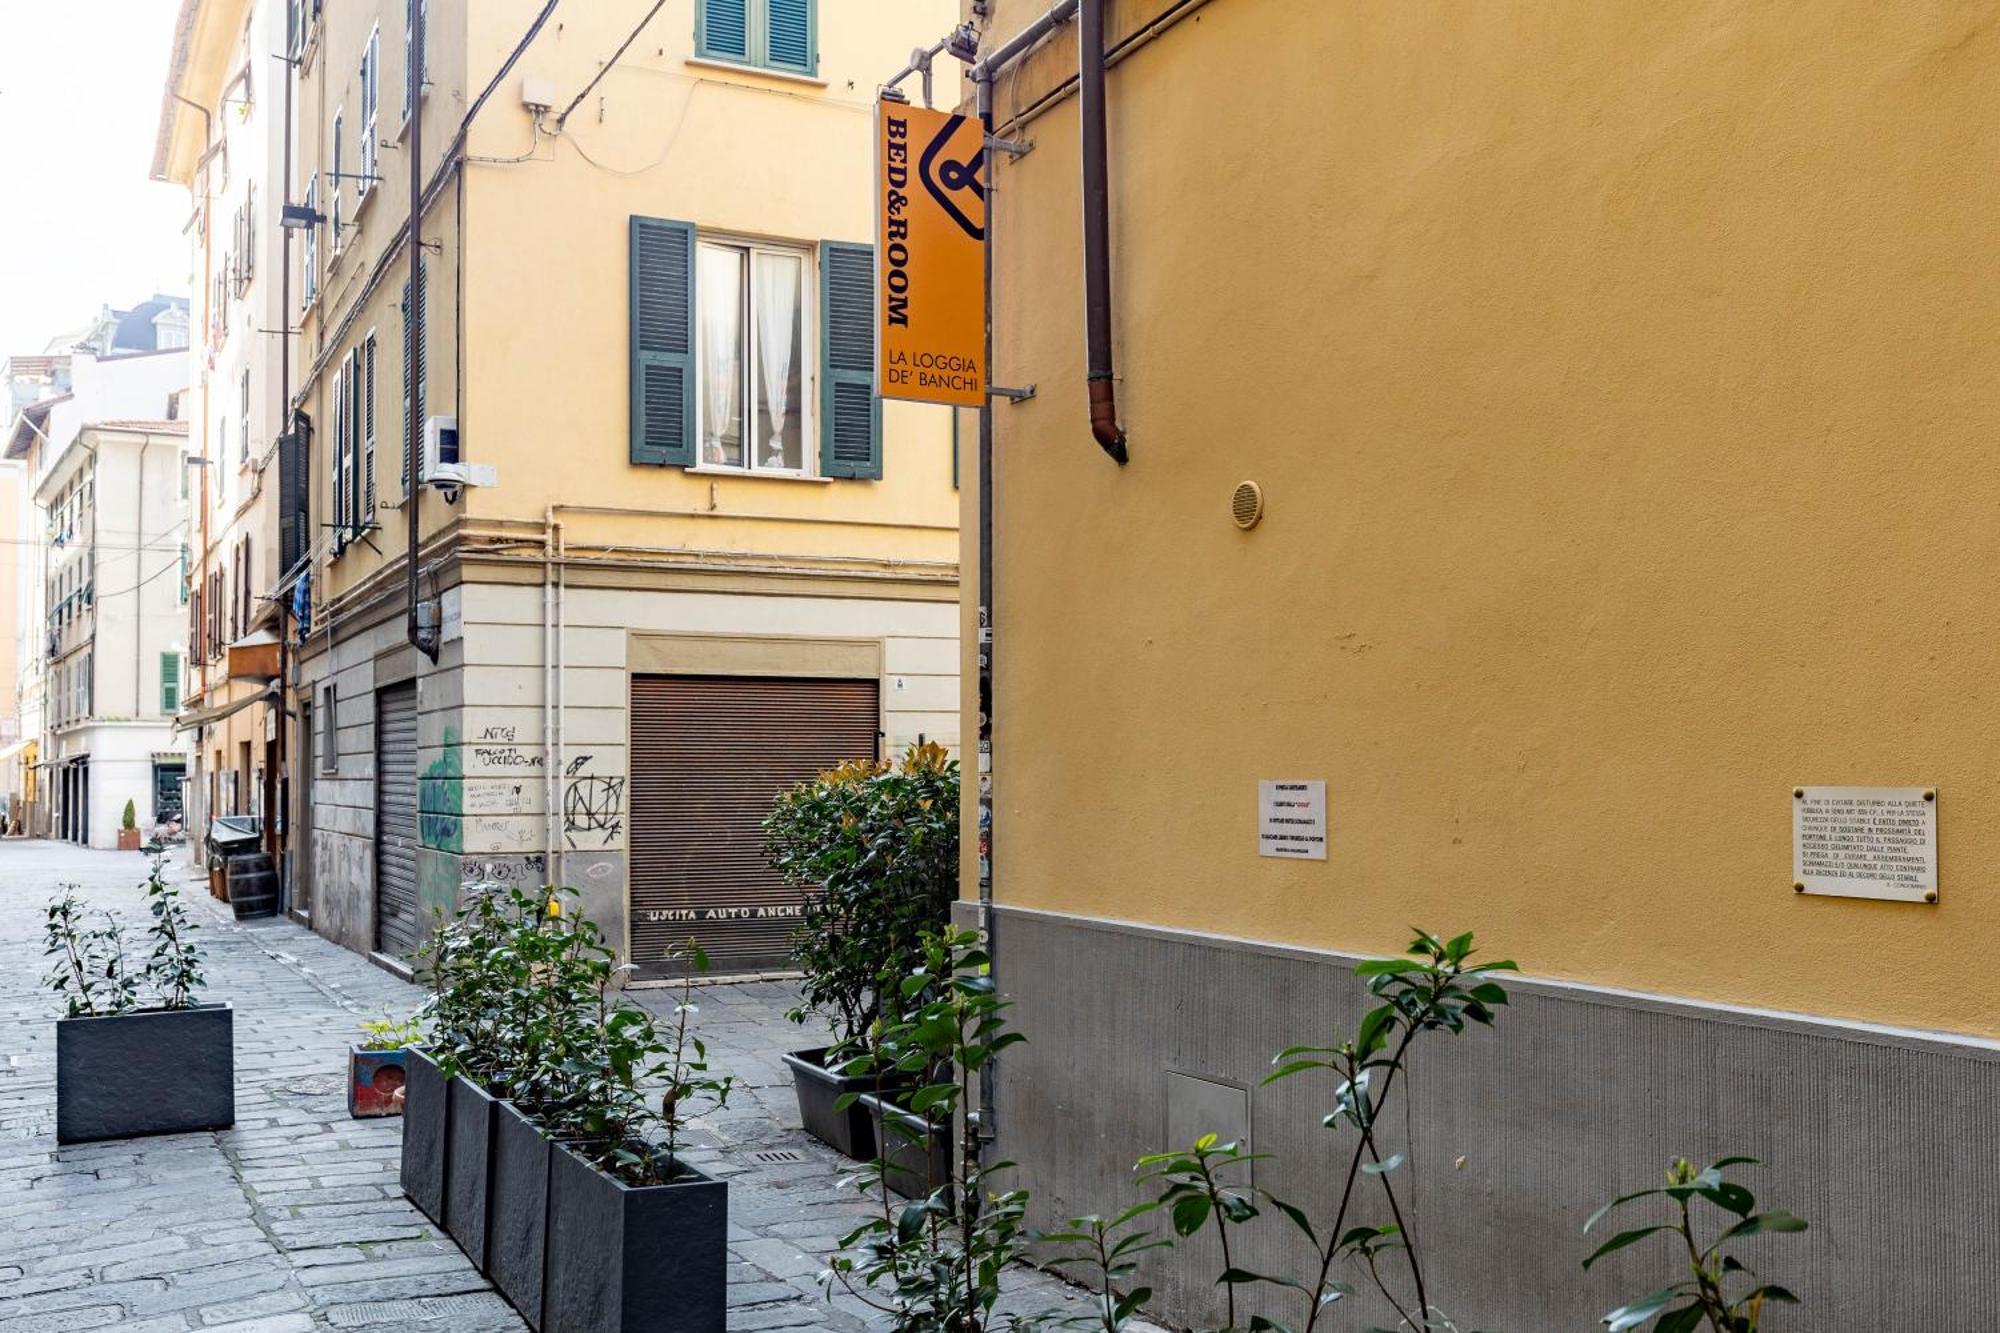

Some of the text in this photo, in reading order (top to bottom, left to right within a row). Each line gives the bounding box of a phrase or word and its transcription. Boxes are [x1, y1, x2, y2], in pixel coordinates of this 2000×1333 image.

[887, 115, 909, 328] BED&ROOM
[888, 348, 977, 374] LA LOGGIA
[888, 368, 978, 392] DE' BANCHI
[650, 909, 696, 921] USCITA
[706, 908, 750, 919] AUTO
[757, 906, 801, 918] ANCHE
